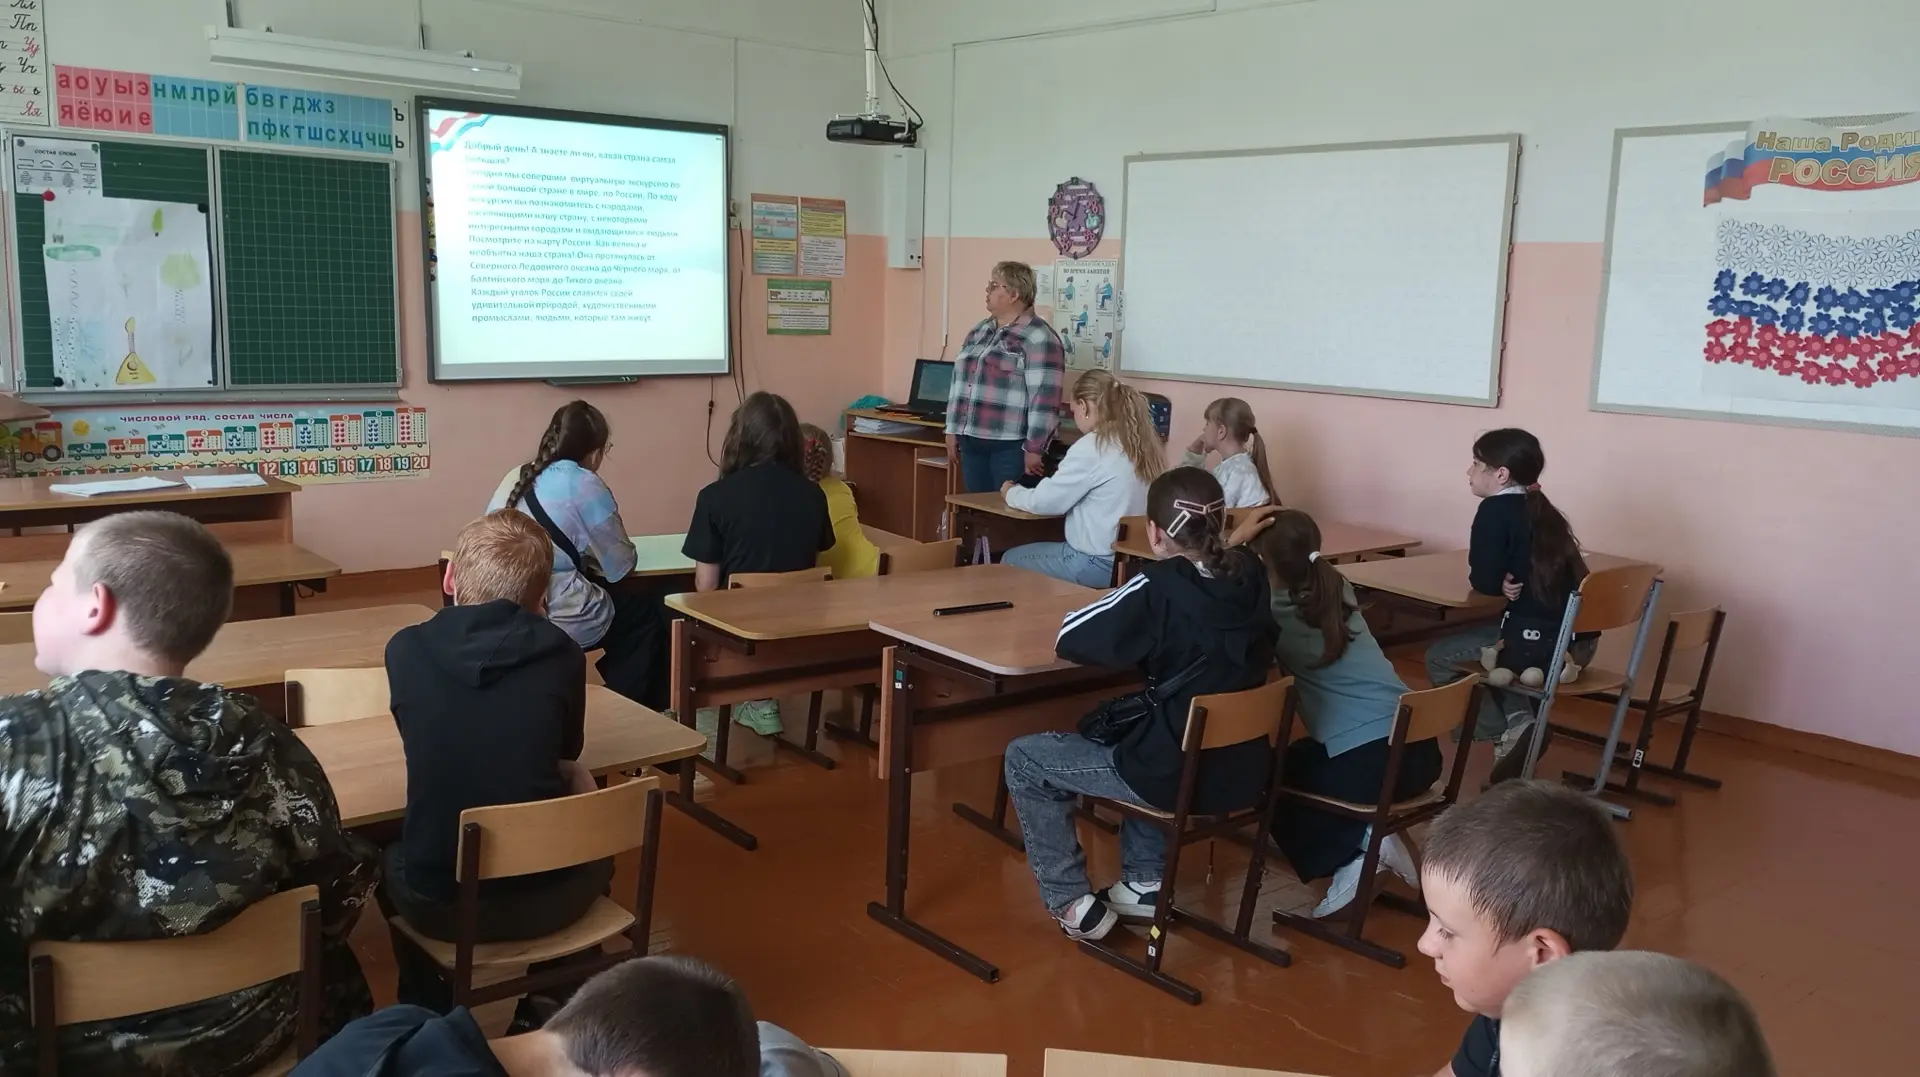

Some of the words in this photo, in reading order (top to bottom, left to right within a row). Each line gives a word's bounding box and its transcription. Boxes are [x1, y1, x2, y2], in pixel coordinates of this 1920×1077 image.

[1756, 131, 1832, 152] Наша
[464, 140, 502, 151] Добрый
[503, 145, 529, 153] день!
[540, 148, 568, 156] знаете
[623, 153, 650, 162] страна
[652, 156, 676, 164] самая
[1768, 152, 1920, 186] РОССИЯ
[521, 172, 567, 182] совершим
[570, 176, 625, 186] виртуальную
[497, 183, 537, 193] большой
[538, 187, 568, 196] стране
[531, 225, 573, 234] городами
[469, 234, 522, 245] Посмотрите
[577, 250, 593, 259] Она
[470, 261, 517, 271] Северного
[570, 264, 599, 272] океана
[470, 275, 526, 284] Балтийского
[471, 287, 509, 297] Каждый
[510, 288, 539, 297] уголок
[541, 288, 571, 297] России
[471, 301, 535, 311] удивительной
[120, 414, 181, 423] ЧИСЛОВОЙ
[214, 413, 255, 421] СОСТАВ
[263, 462, 277, 475] 12
[282, 461, 297, 475] 13
[302, 460, 317, 474] 14
[321, 459, 336, 473] 15
[341, 459, 355, 472] 16
[360, 458, 373, 471] 17
[378, 458, 391, 470] 18
[396, 457, 409, 470] 19
[413, 456, 428, 469] 20
